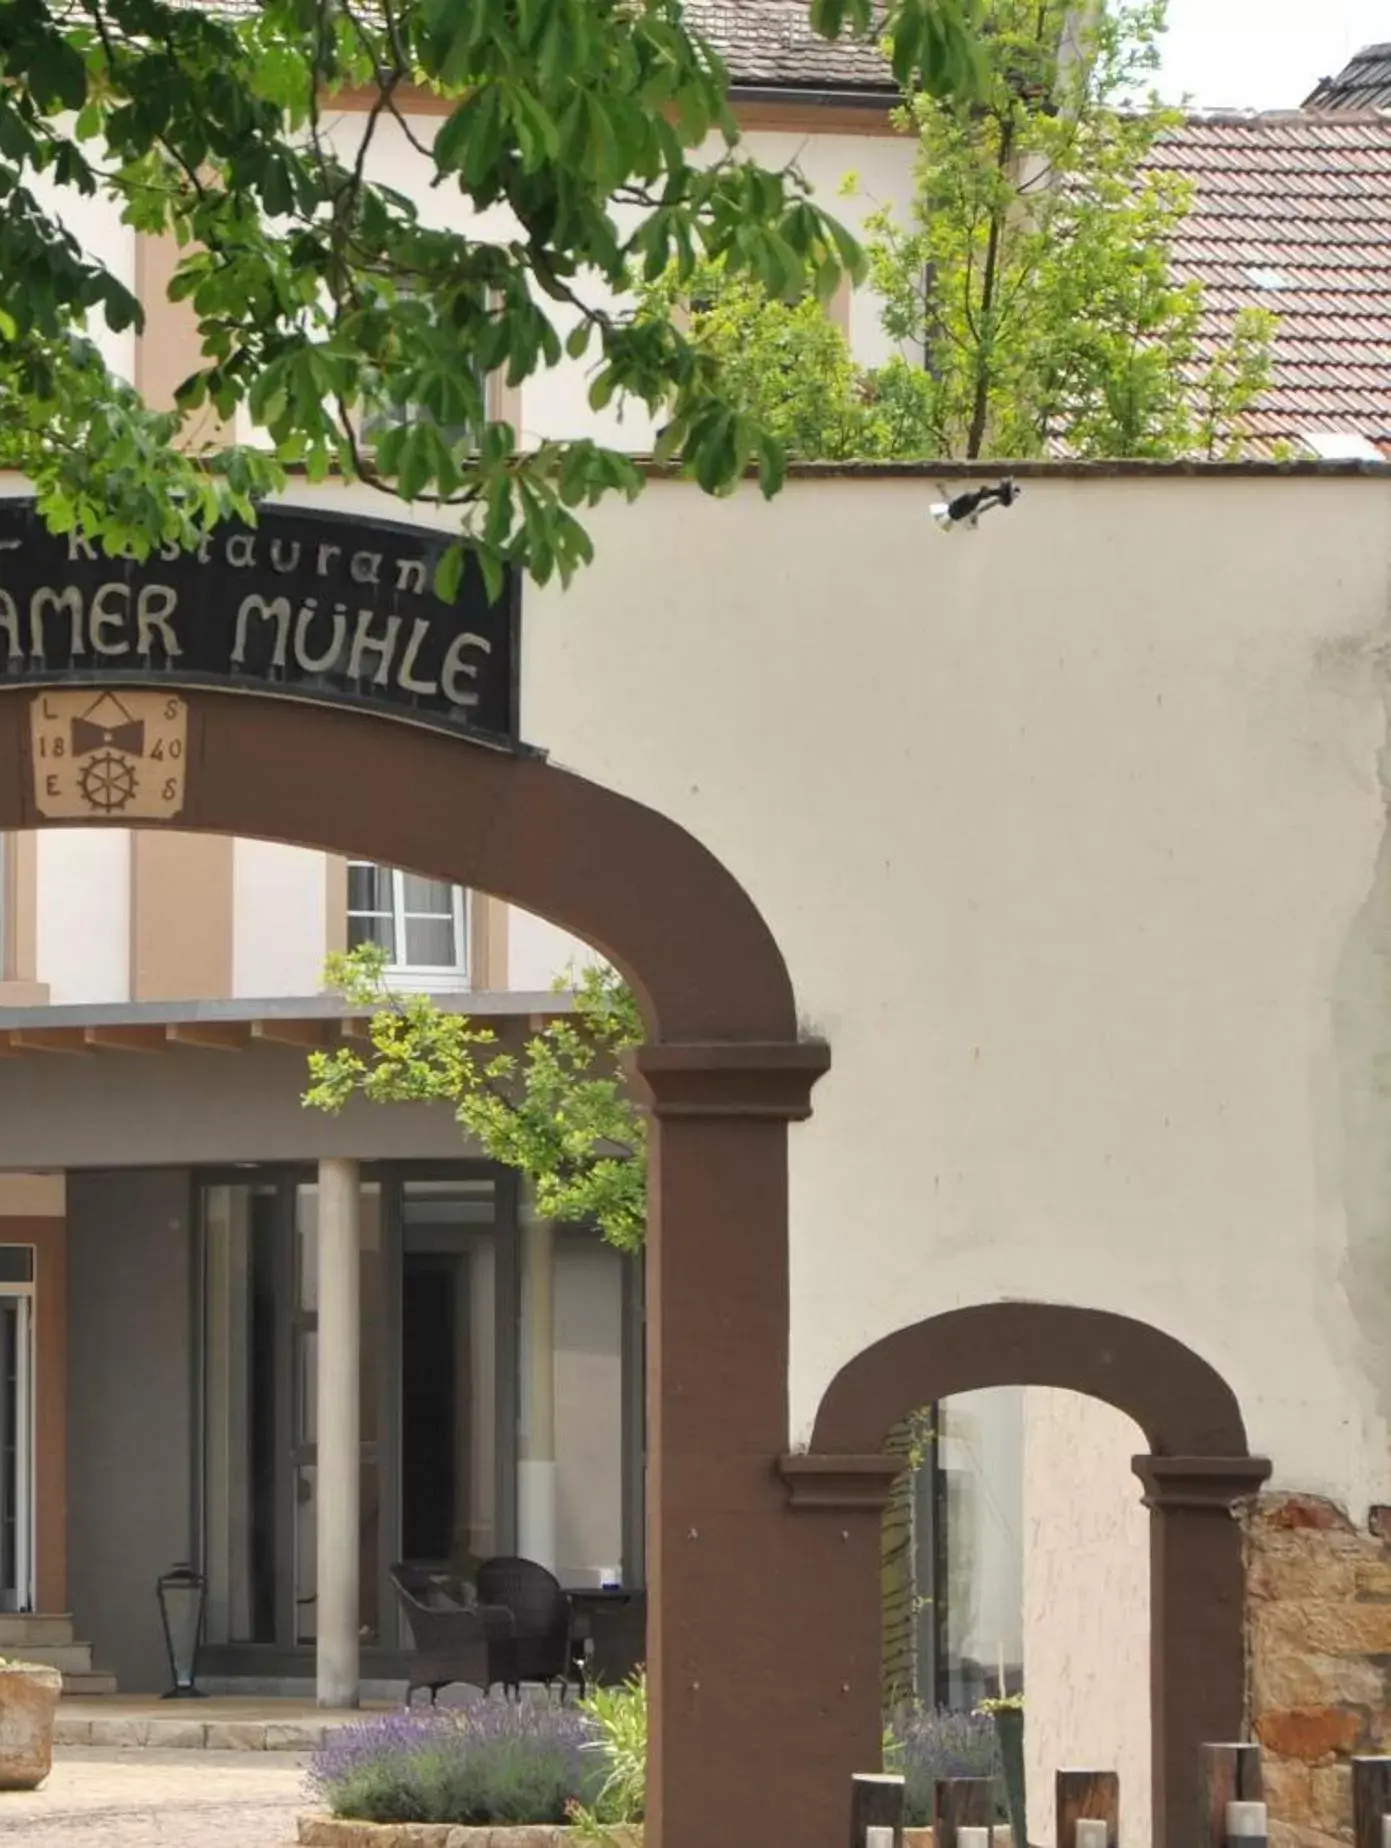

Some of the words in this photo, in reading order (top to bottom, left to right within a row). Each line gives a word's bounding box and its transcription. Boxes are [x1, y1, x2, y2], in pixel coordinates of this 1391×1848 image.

[68, 518, 428, 595] Rstauran
[229, 594, 492, 706] MÜHLE
[42, 697, 59, 720] L
[163, 699, 179, 721] S
[38, 736, 65, 759] 18
[149, 737, 183, 762] 40
[46, 774, 62, 796] E
[161, 777, 178, 801] S
